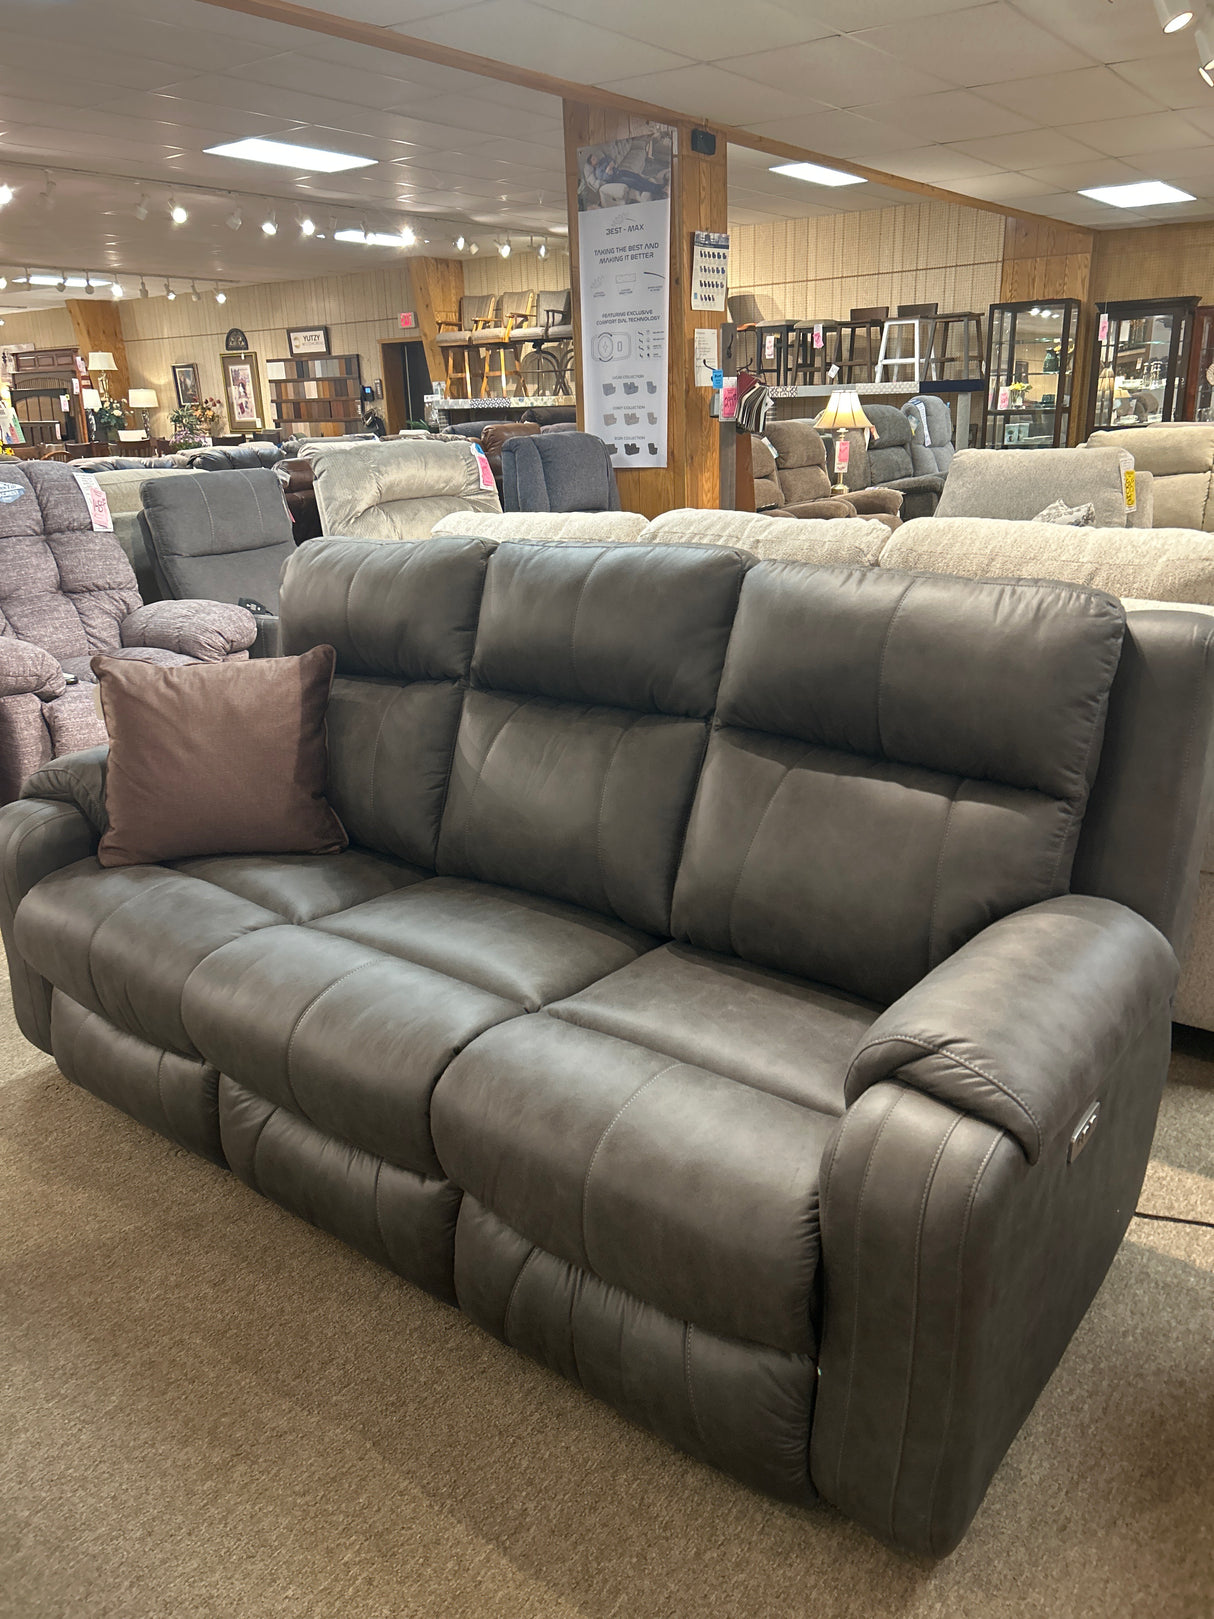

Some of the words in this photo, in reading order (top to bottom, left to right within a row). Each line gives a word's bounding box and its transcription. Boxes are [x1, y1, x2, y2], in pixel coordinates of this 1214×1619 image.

[628, 224, 644, 232] MAX
[594, 247, 614, 256] TAKING
[628, 244, 643, 252] BEST
[599, 256, 623, 264] MAKING
[631, 252, 654, 260] BETTER
